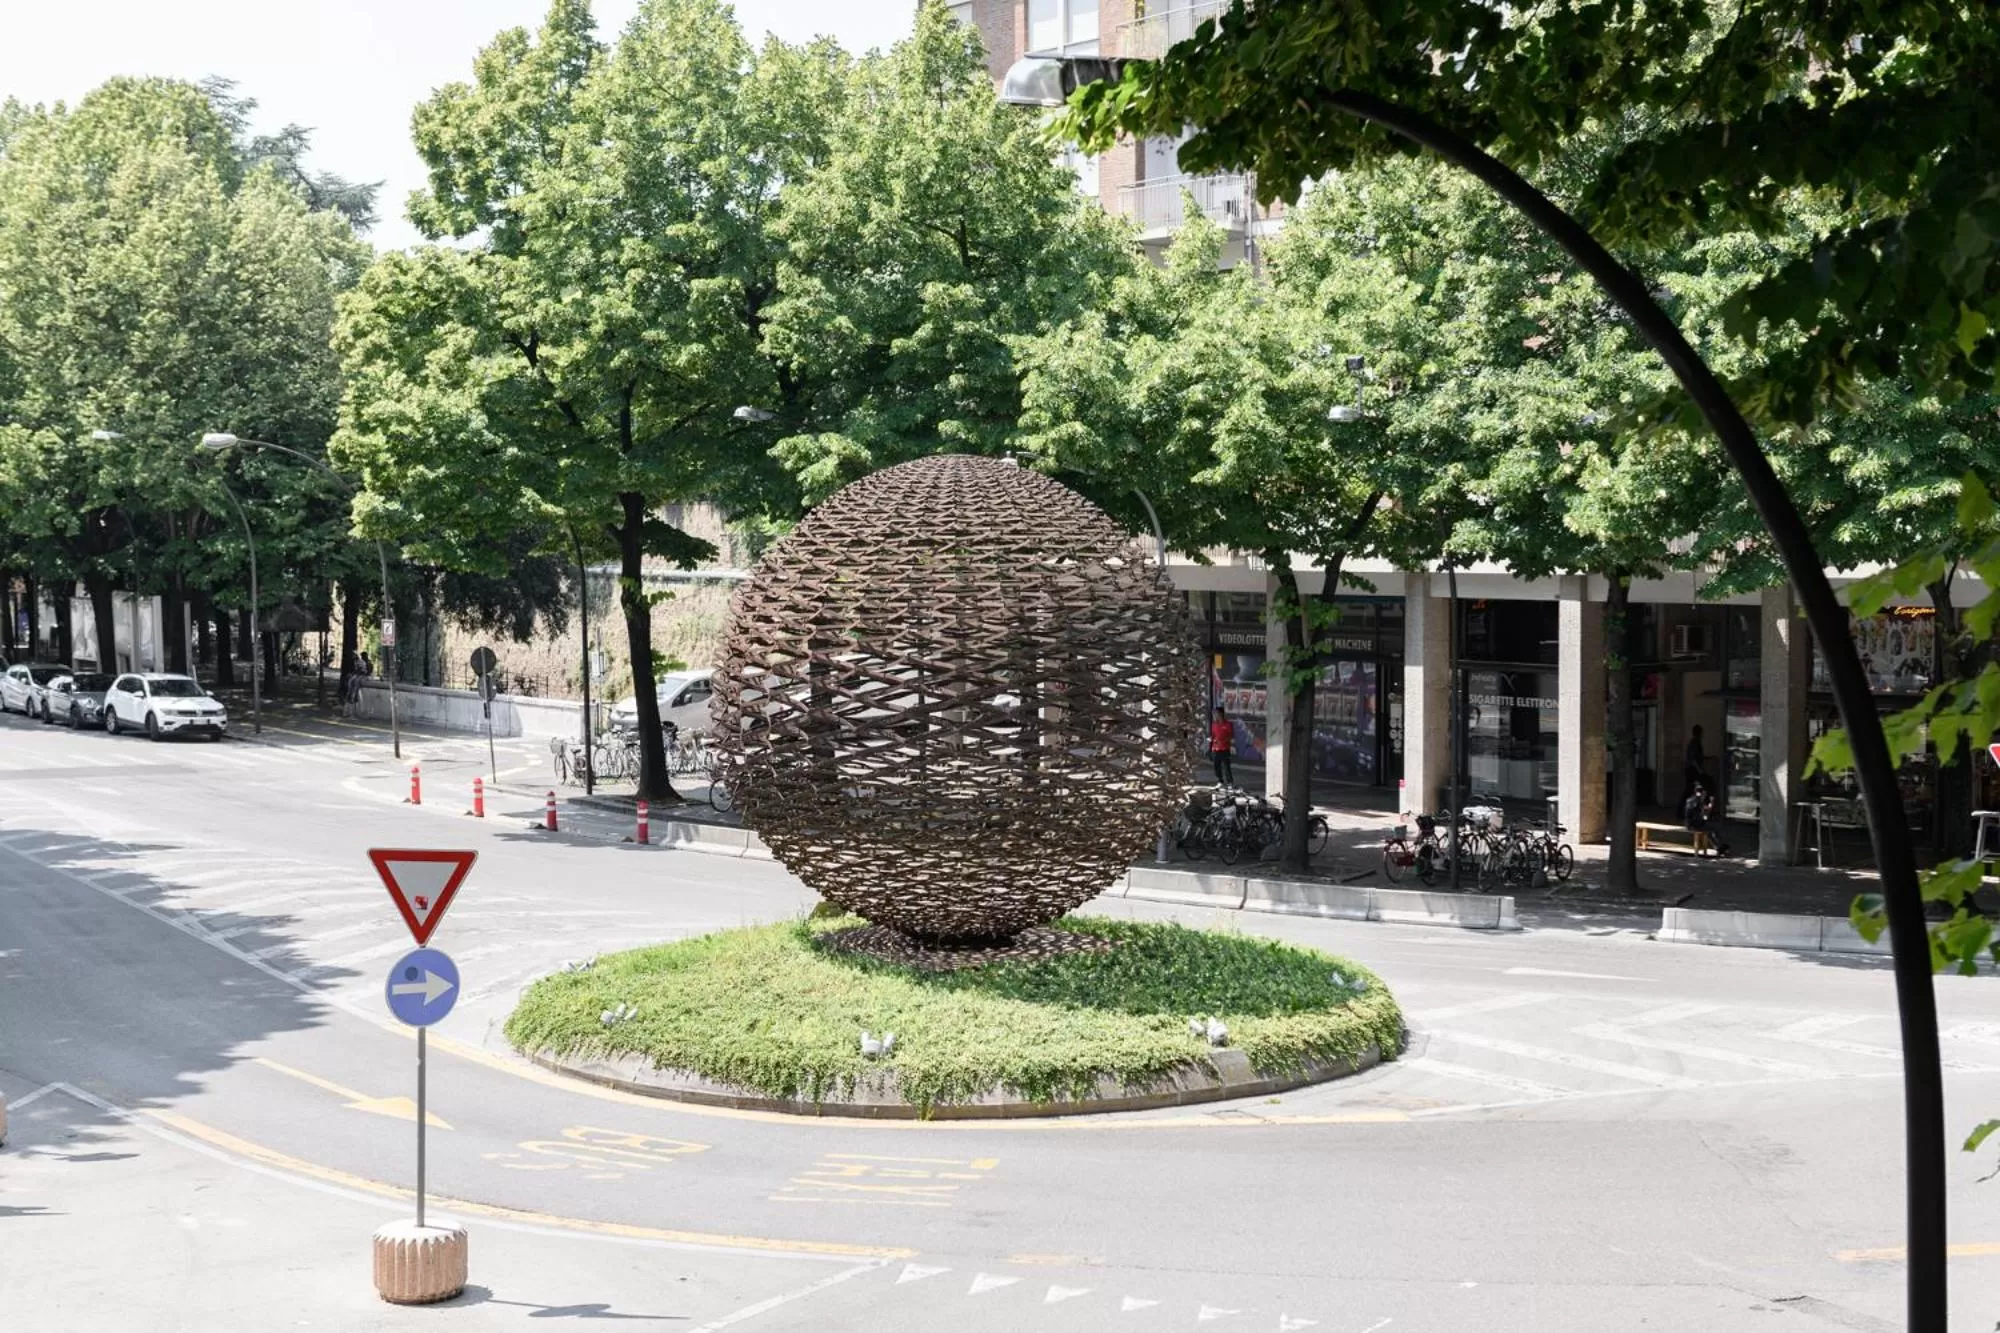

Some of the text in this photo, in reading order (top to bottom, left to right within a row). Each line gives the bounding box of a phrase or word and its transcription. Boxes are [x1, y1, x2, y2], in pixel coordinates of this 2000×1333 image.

[1335, 639, 1373, 652] MACHINE
[1469, 694, 1515, 706] SIGARETTE
[480, 1124, 712, 1179] BUS
[768, 1153, 1000, 1207] TAXI
